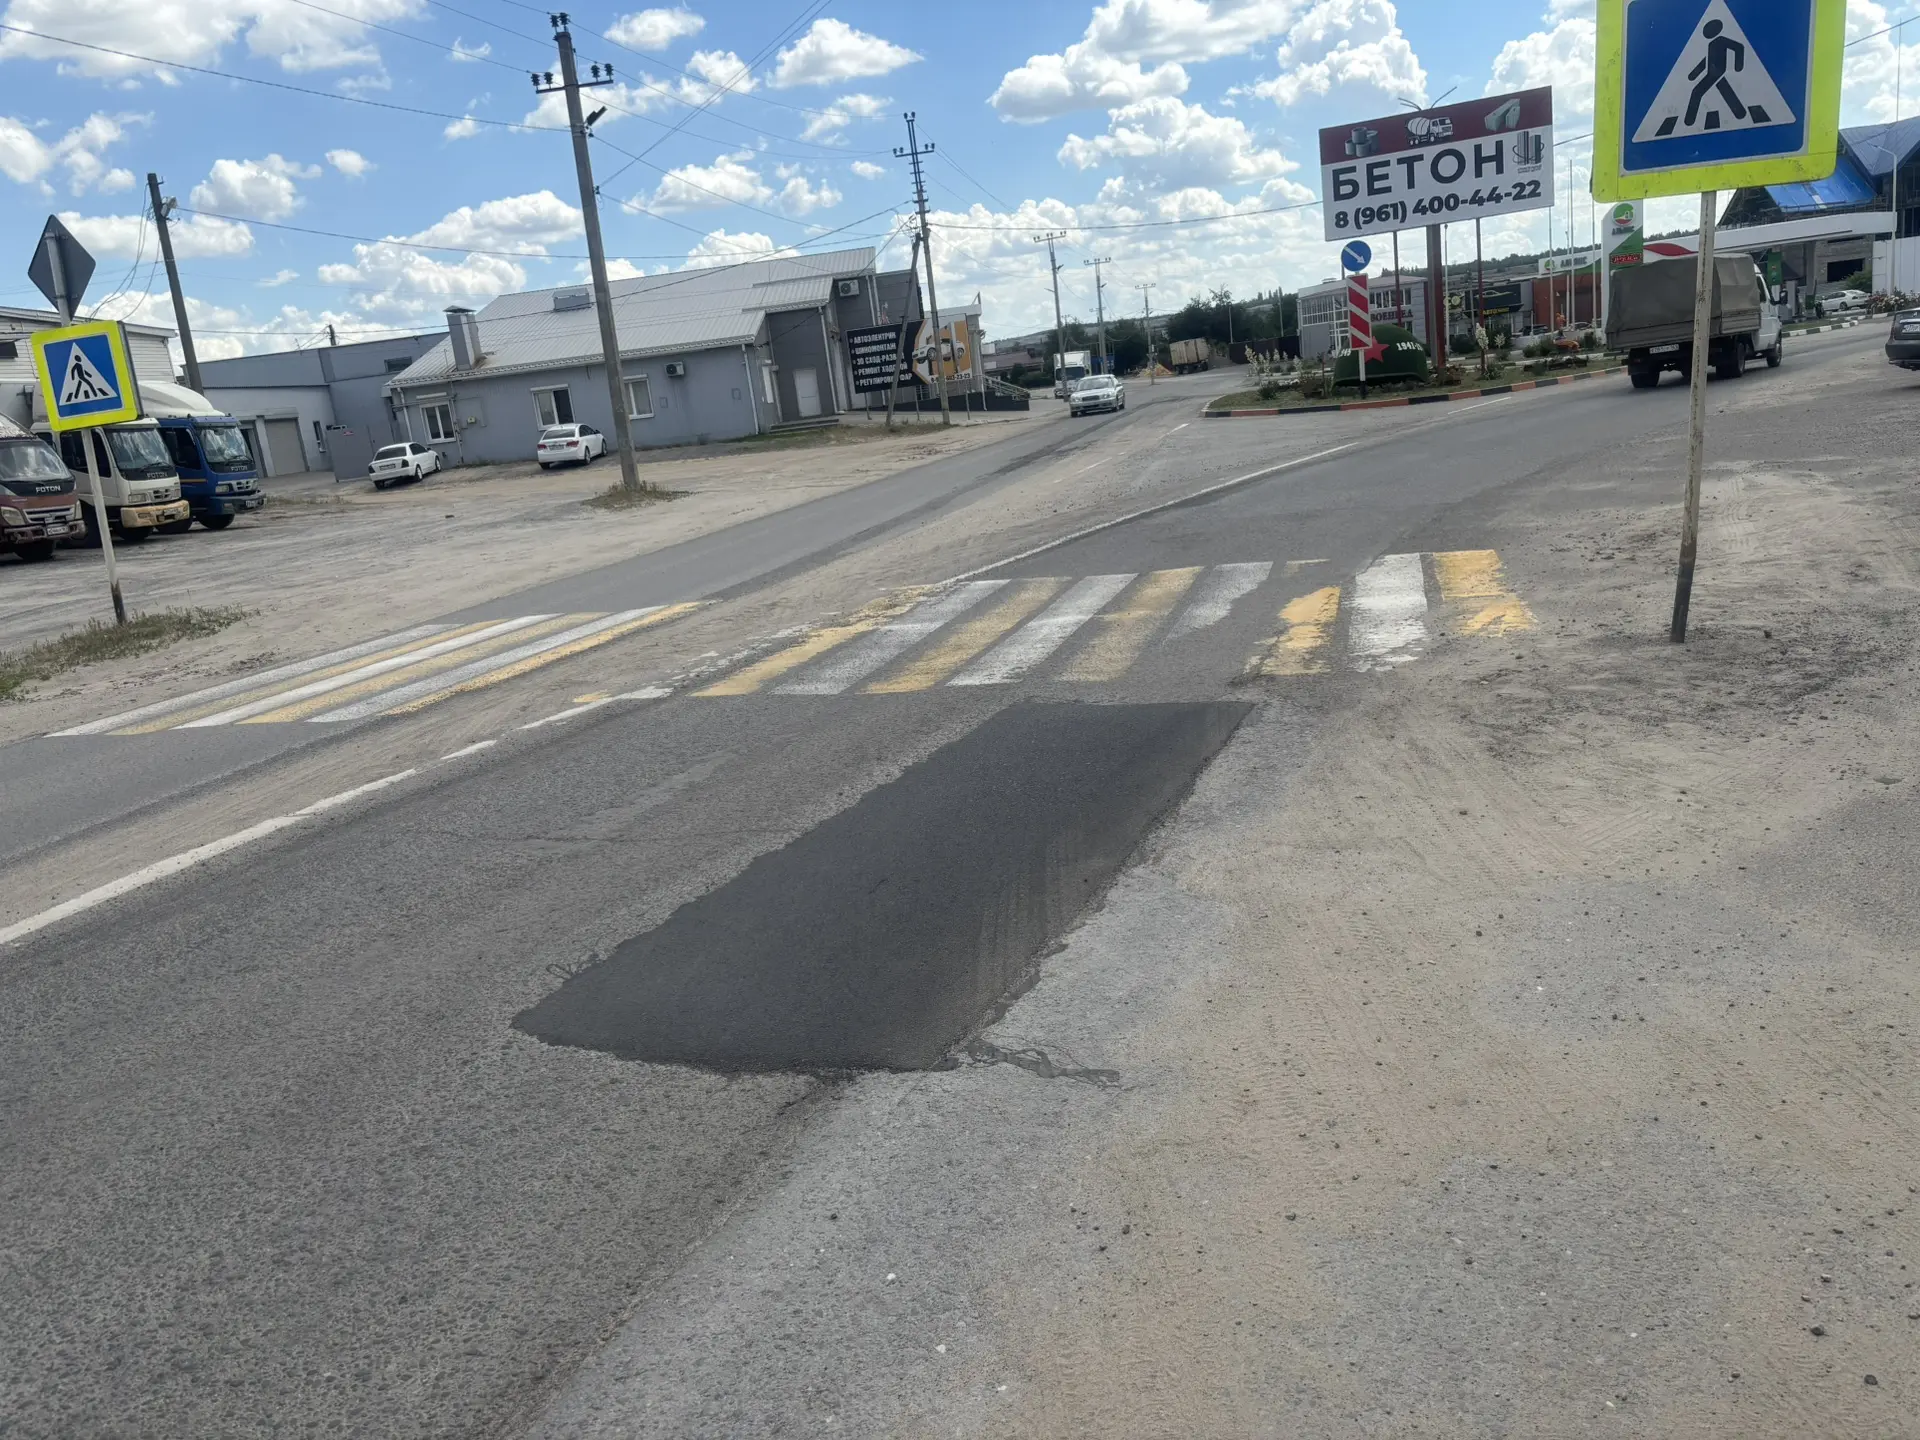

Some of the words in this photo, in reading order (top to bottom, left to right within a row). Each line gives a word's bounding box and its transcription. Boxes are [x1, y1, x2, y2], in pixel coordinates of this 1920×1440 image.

[1332, 140, 1504, 202] БЕТОН
[1335, 211, 1349, 228] 8
[1354, 201, 1407, 230] (961)
[1412, 180, 1541, 215] 400-44-22
[854, 332, 896, 344] АВТОЭЛЕКТРИК
[865, 353, 904, 364] СХОД-РАЗВ
[858, 366, 880, 376] РЕМОНТ
[36, 485, 61, 493] FOTON
